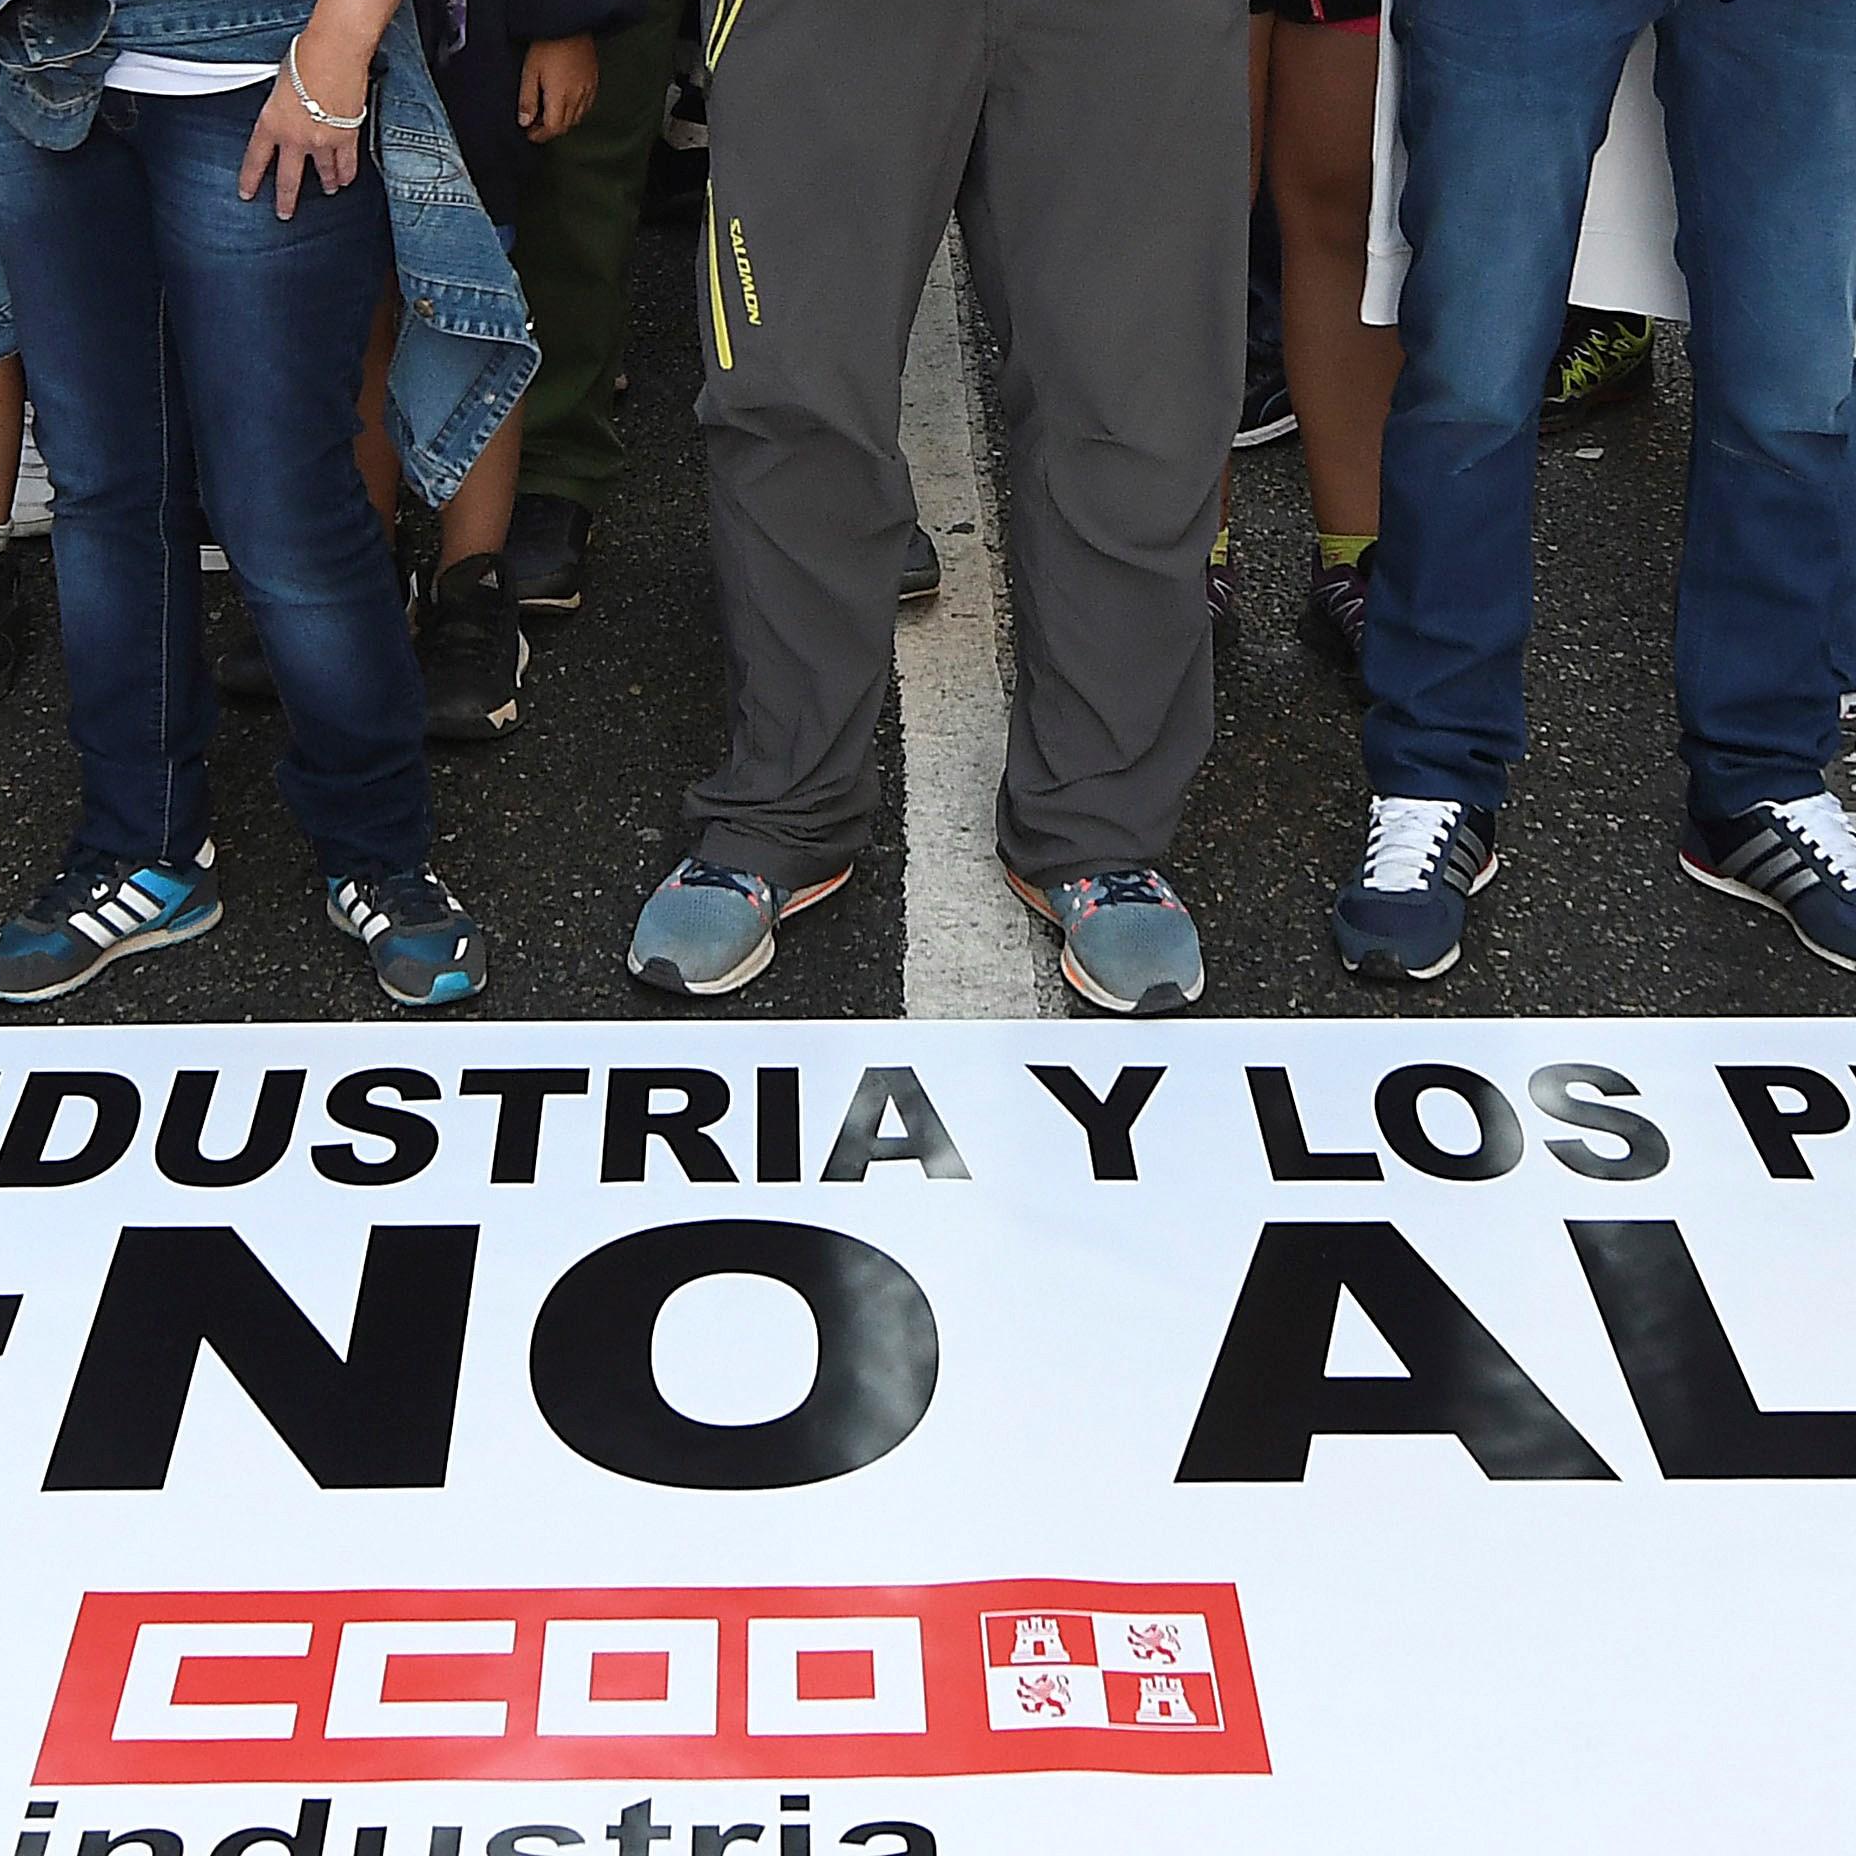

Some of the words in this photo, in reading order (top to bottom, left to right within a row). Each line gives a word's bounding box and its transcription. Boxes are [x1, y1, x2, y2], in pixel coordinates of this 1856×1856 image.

[727, 217, 762, 327] SALOMON
[1025, 1064, 1167, 1181] Y
[1244, 1062, 1671, 1183] LOS
[109, 1616, 929, 1741] CCOO
